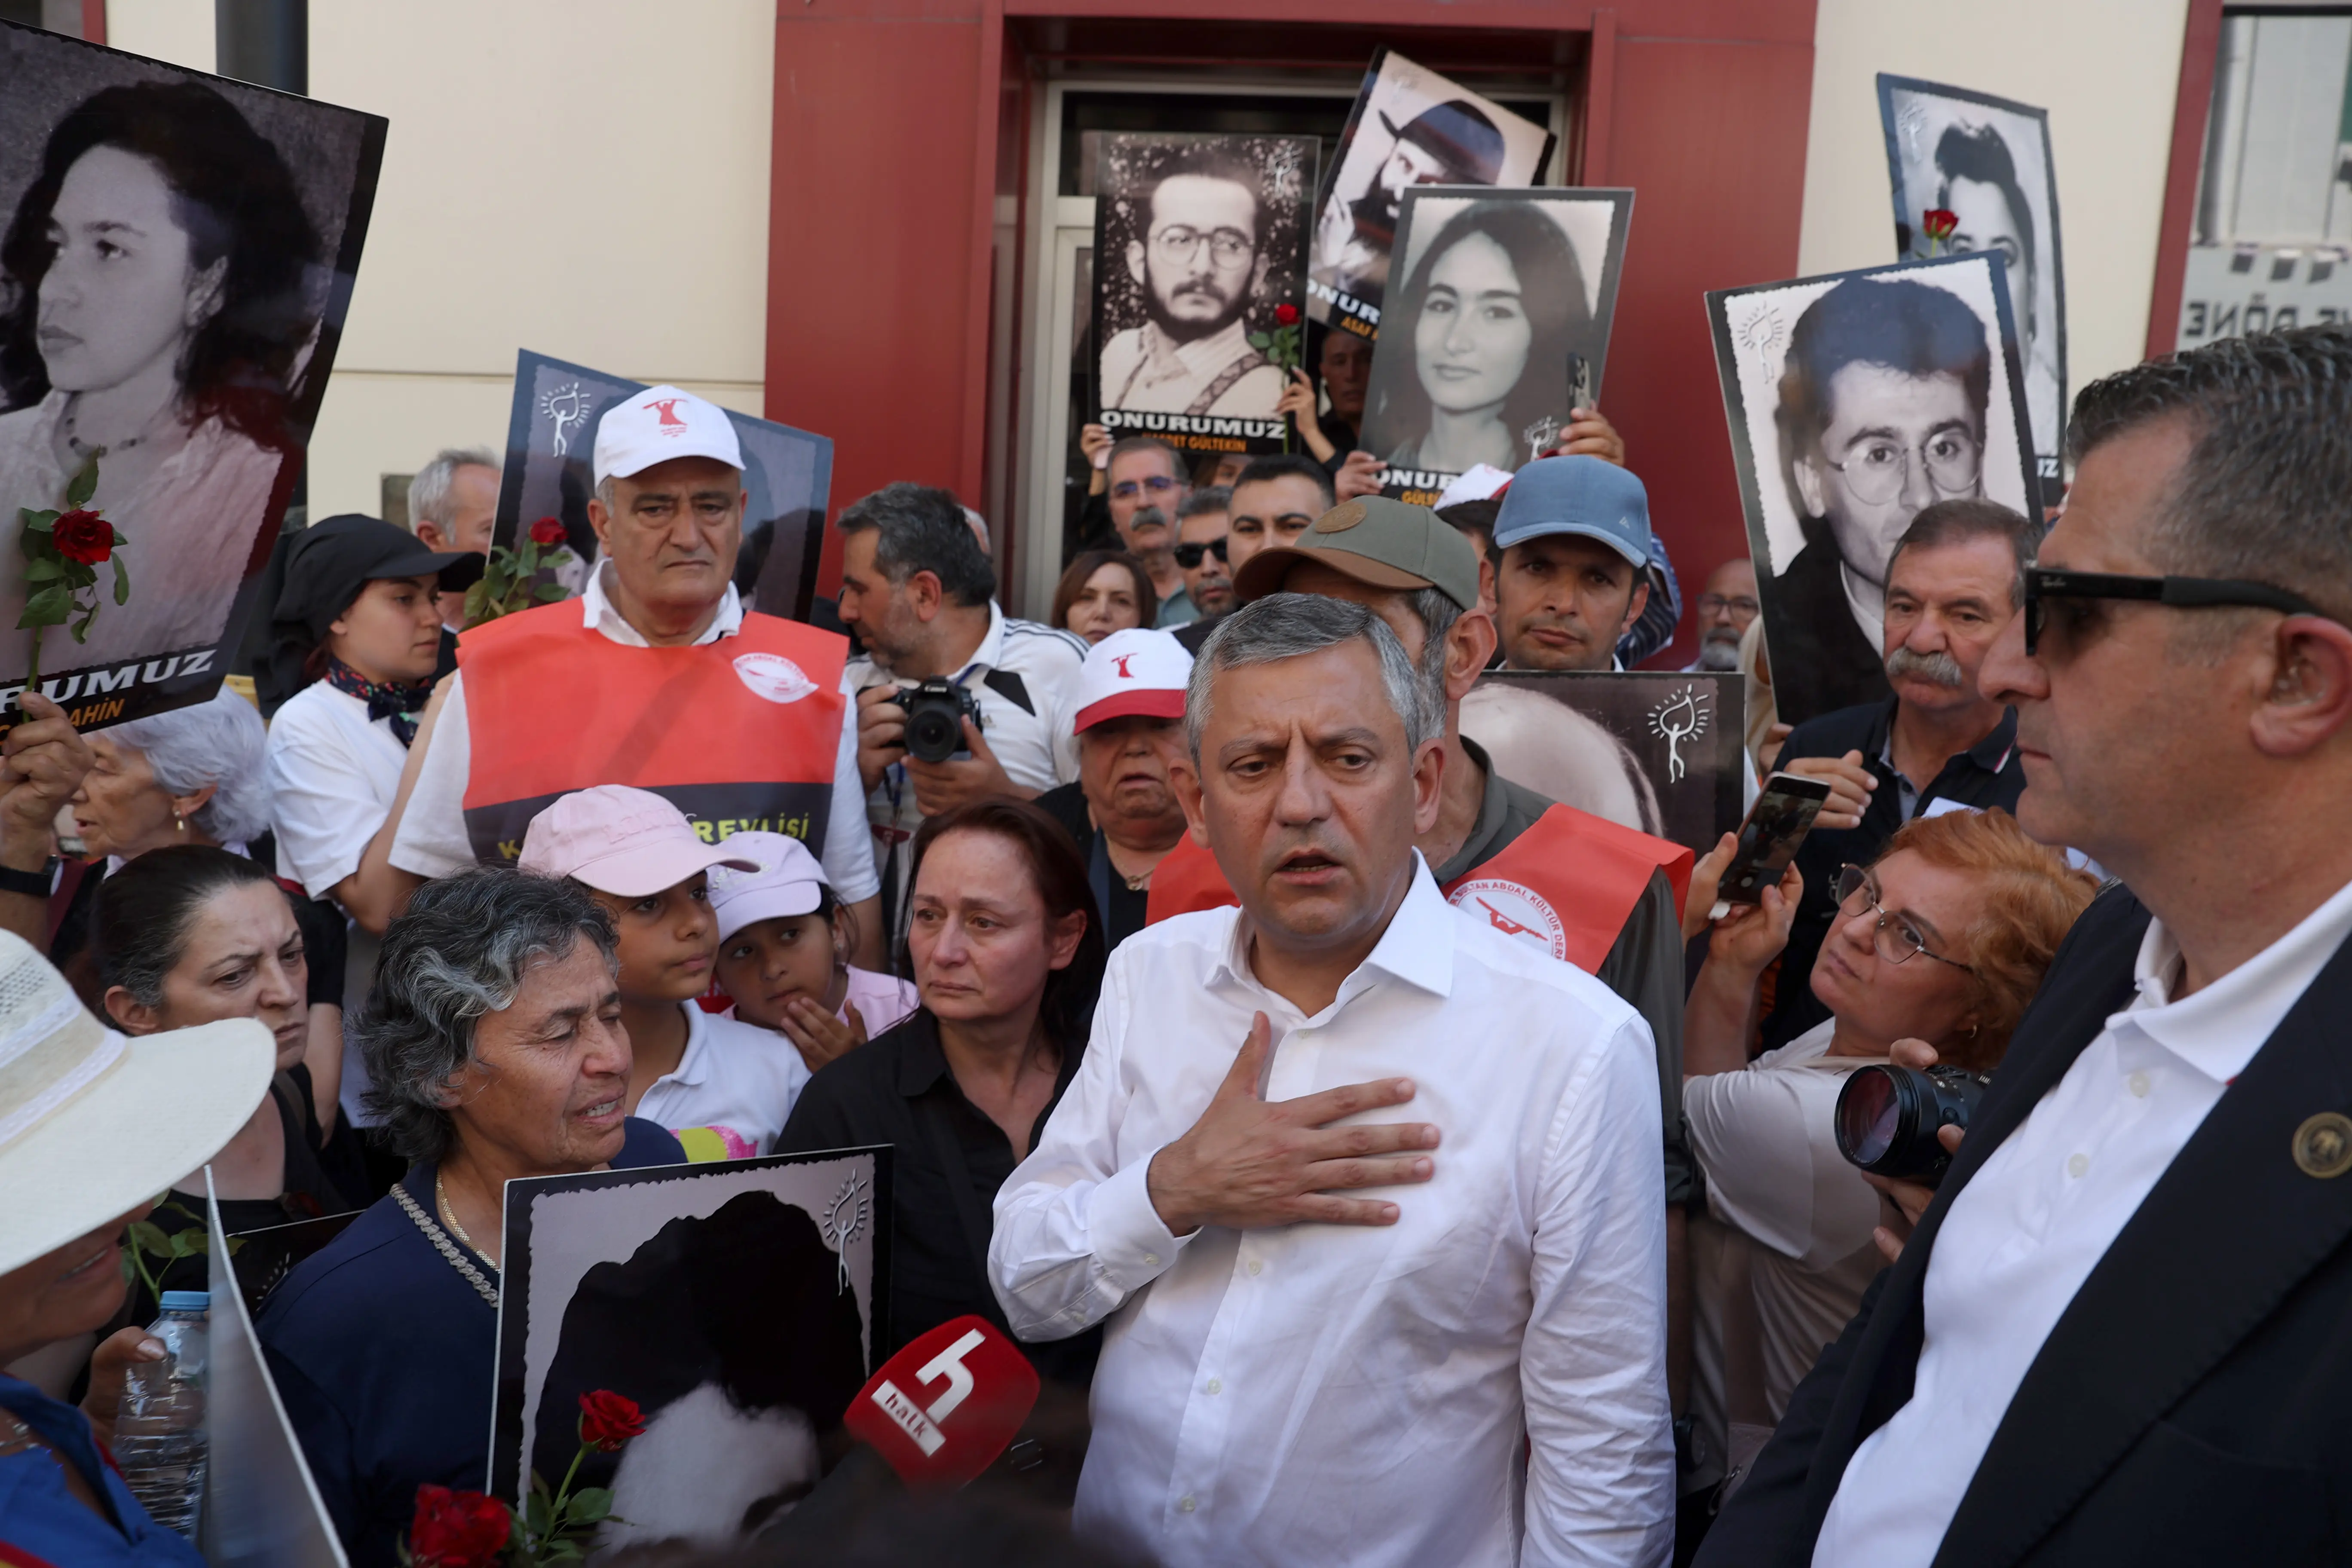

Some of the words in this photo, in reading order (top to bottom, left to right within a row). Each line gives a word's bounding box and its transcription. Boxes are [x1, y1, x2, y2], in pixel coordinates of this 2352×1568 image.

[1100, 411, 1286, 439] ONURUMUZ
[70, 697, 126, 726] AHİN
[1492, 882, 1527, 896] ABDAL
[1529, 895, 1560, 931] KÜLTÜR
[885, 1391, 928, 1439] halk
